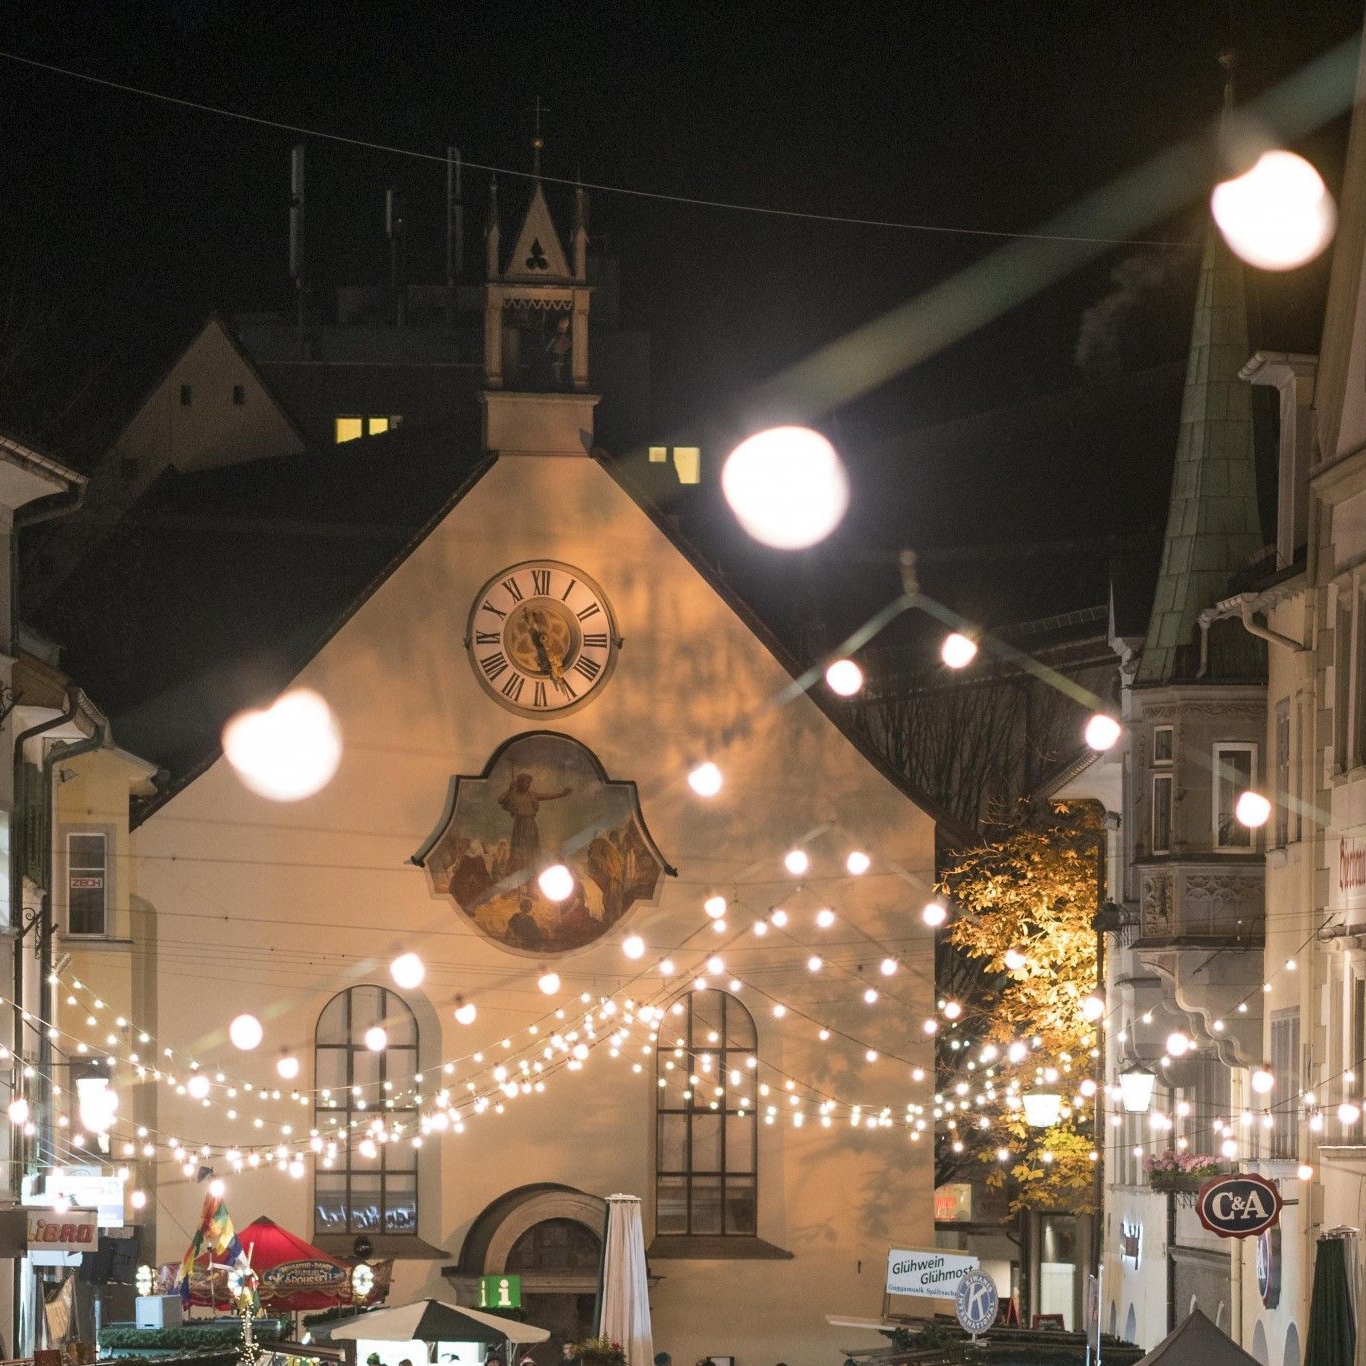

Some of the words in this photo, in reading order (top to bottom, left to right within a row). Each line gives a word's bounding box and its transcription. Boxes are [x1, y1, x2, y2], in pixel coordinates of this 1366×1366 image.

[531, 570, 551, 595] XII
[482, 600, 507, 621] X
[576, 602, 601, 622] II
[583, 633, 607, 648] III
[72, 878, 101, 887] ZECH
[1211, 1189, 1268, 1221] C&A
[892, 1255, 945, 1275] Glühwein
[920, 1265, 974, 1285] Glühmost
[888, 1284, 924, 1294] Guggamusik
[965, 1274, 994, 1294] KIWANIS
[957, 1292, 995, 1329] INTERNATIONAL
[967, 1283, 987, 1321] K
